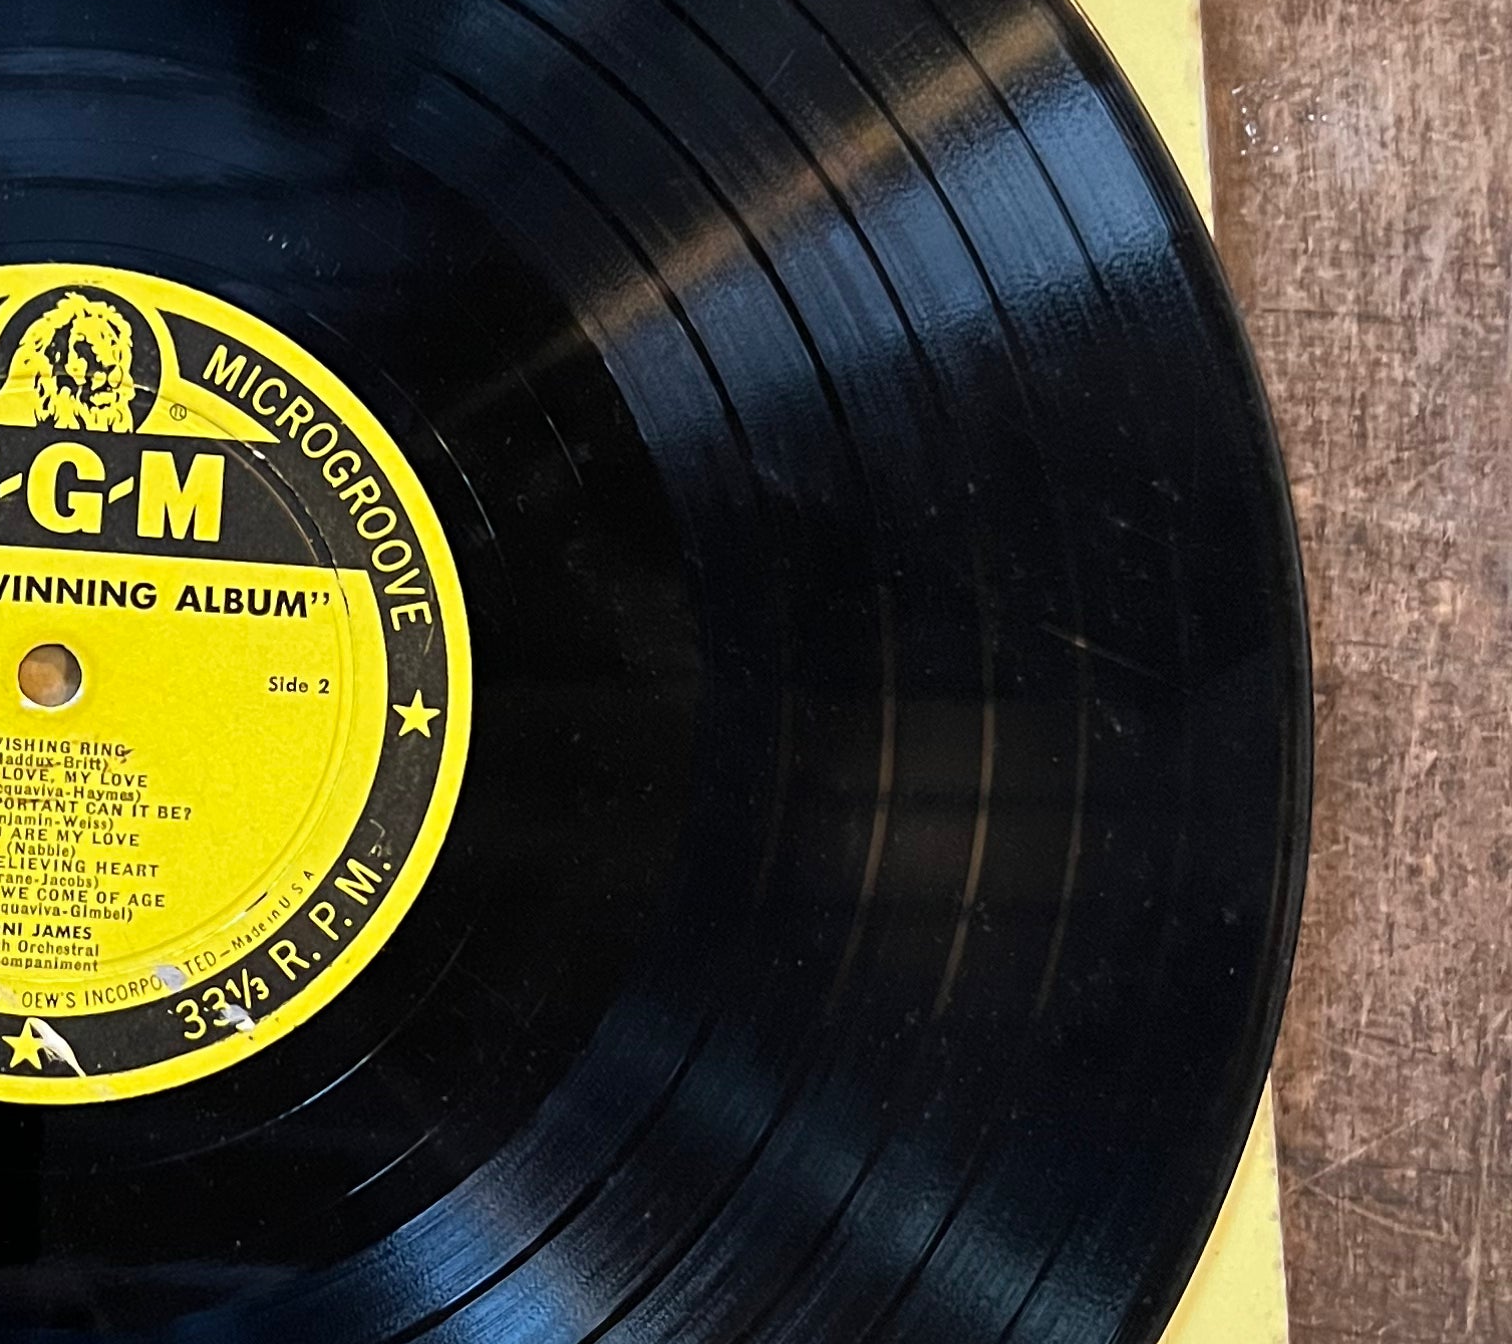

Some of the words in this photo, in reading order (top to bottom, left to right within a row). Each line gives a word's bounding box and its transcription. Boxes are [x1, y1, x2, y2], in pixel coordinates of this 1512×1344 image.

[202, 344, 433, 632] MICROGROOVE
[268, 676, 309, 694] Side
[318, 678, 330, 694] 2
[80, 741, 126, 757] RING
[2, 767, 55, 783] LOVE,
[64, 771, 91, 784] MY
[100, 773, 148, 788] LOVE
[86, 801, 123, 817] CAN
[132, 803, 150, 818] IT
[157, 805, 192, 821] BE?
[10, 827, 48, 842] ARE
[56, 829, 84, 844] MY
[92, 832, 140, 847] LOVE
[96, 861, 159, 878] HEART
[1, 885, 29, 900] WE
[37, 887, 89, 903] COME
[96, 890, 120, 905] OF
[128, 892, 166, 908] AGE
[32, 923, 92, 940] JAMES
[17, 939, 100, 957] Orchestral
[13, 988, 76, 1009] OEW'S
